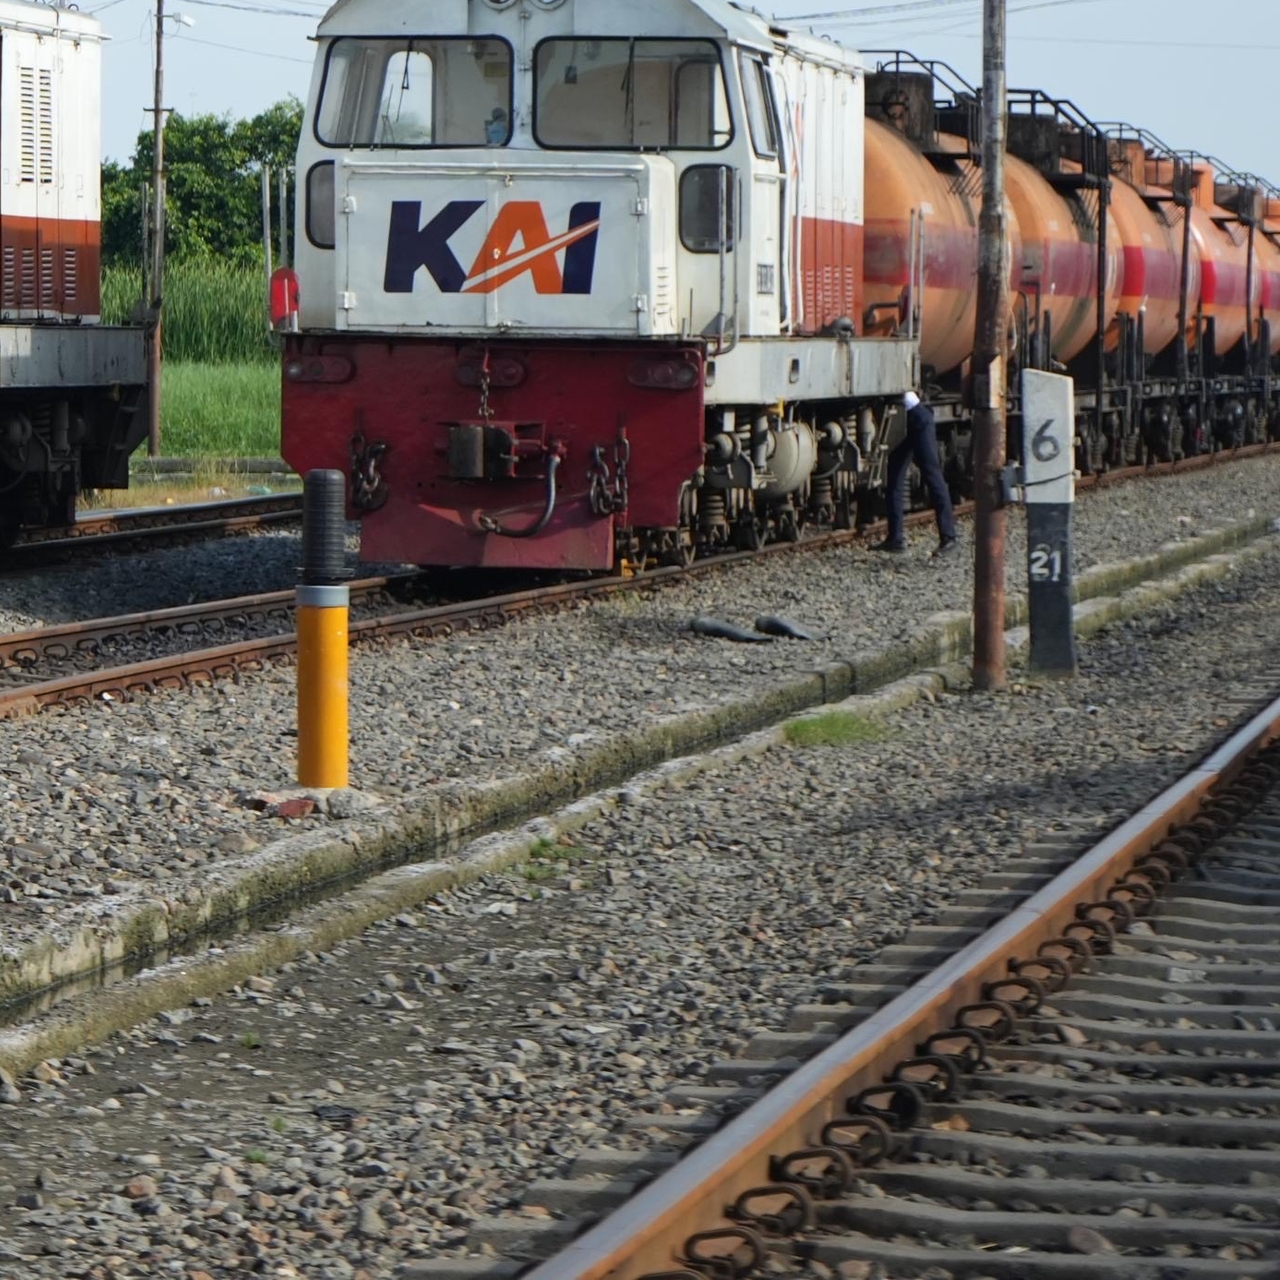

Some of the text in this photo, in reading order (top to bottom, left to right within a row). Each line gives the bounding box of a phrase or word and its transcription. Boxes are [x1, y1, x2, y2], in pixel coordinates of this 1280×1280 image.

[384, 200, 602, 295] KAI
[1031, 419, 1060, 463] 6
[1030, 550, 1062, 582] 21
